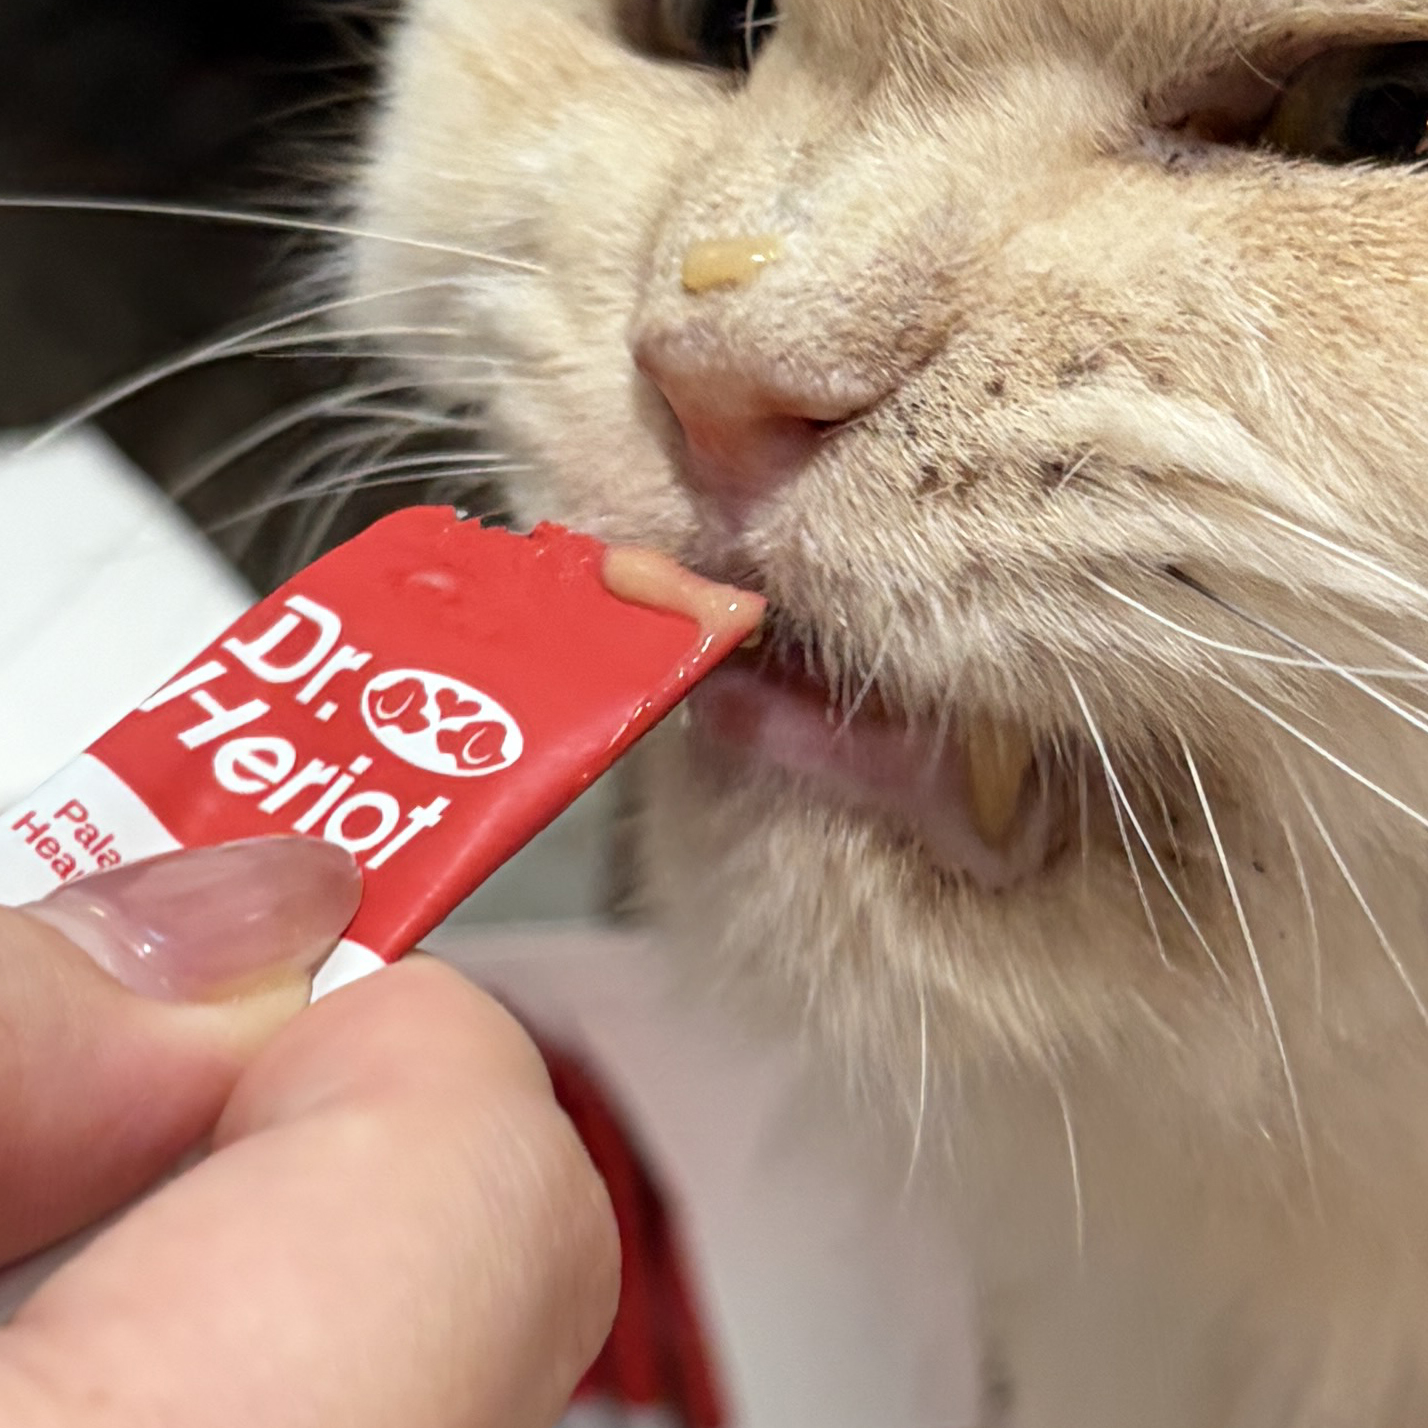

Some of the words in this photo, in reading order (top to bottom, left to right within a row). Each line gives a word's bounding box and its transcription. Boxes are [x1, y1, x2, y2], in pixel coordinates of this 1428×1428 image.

[223, 594, 374, 723] Dr.
[140, 659, 452, 870] Heriot
[10, 809, 86, 882] Hea
[52, 798, 122, 870] Pala
